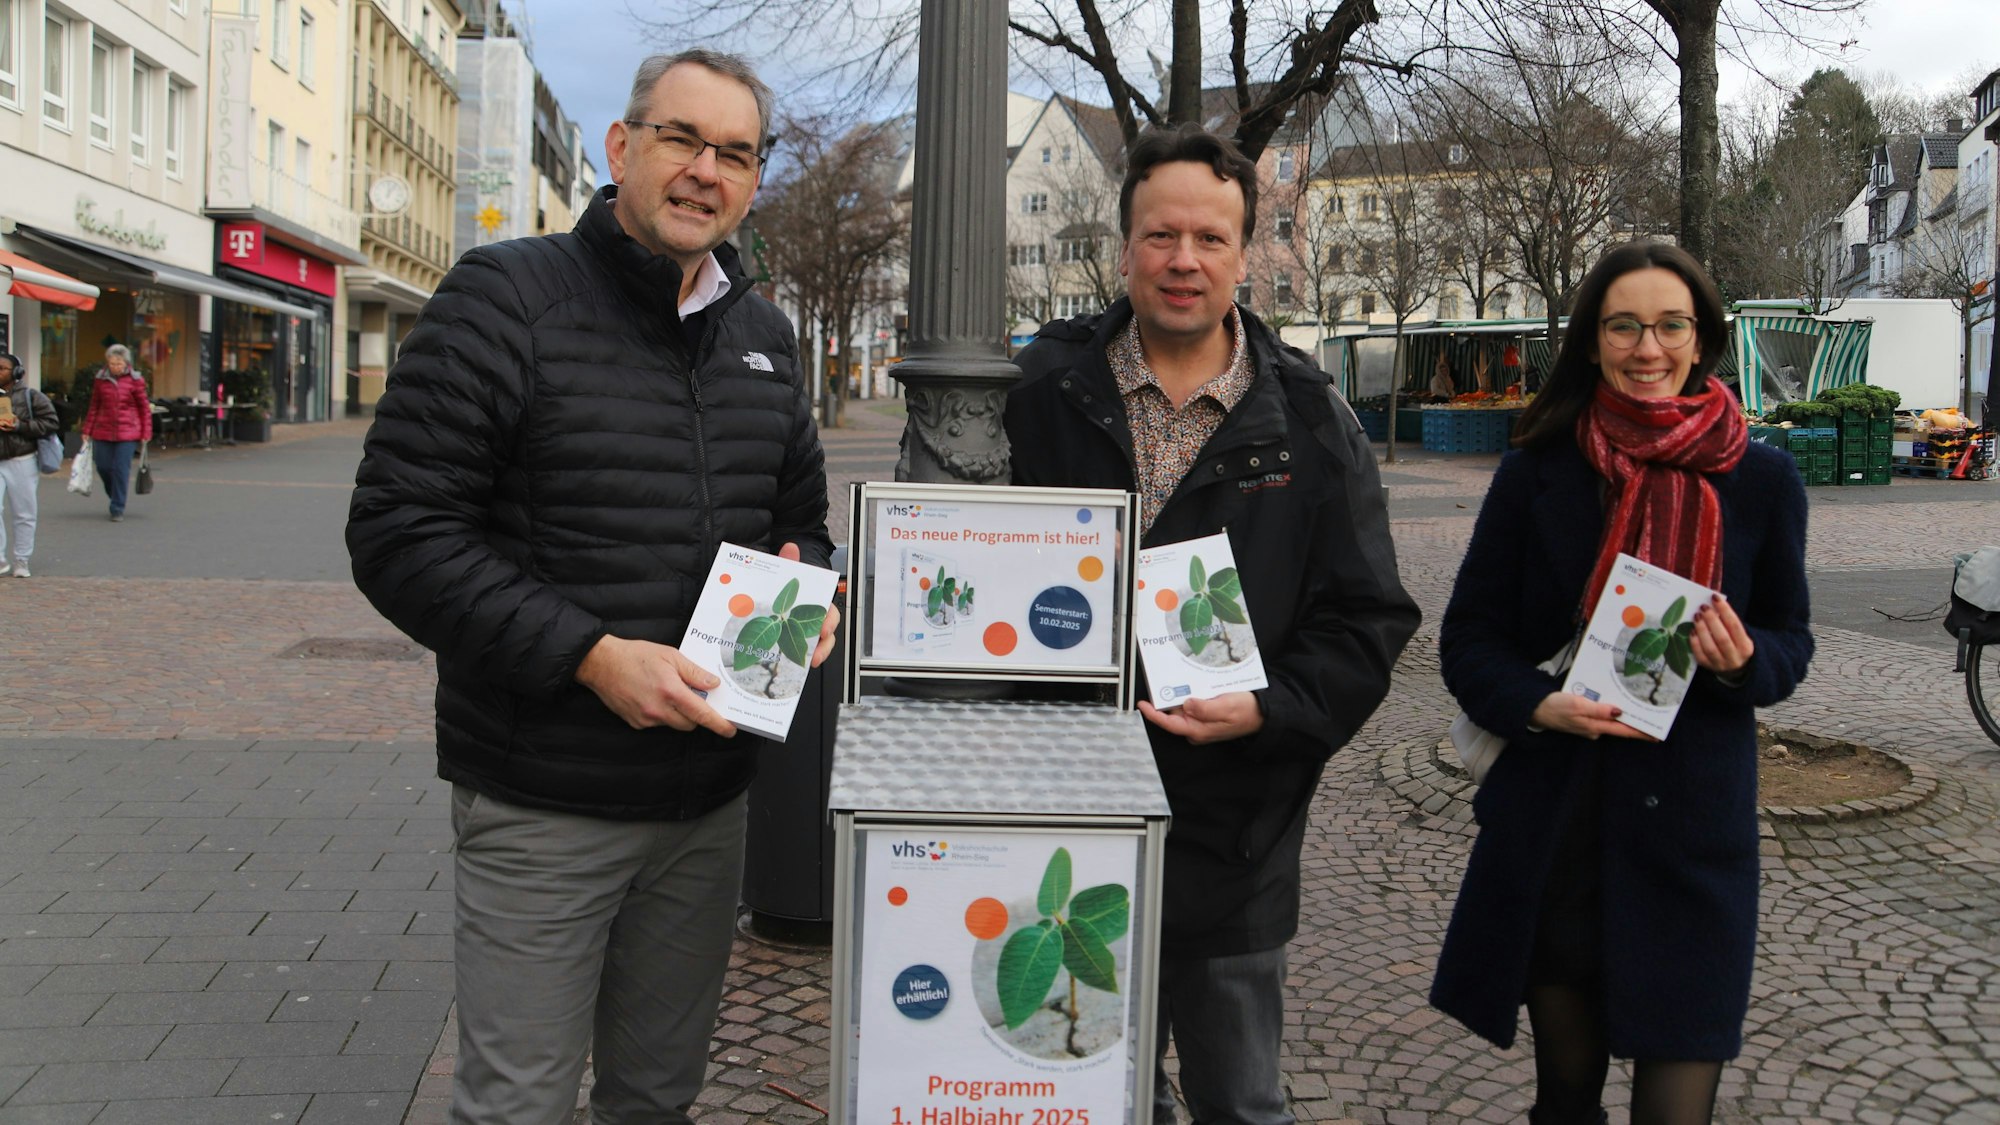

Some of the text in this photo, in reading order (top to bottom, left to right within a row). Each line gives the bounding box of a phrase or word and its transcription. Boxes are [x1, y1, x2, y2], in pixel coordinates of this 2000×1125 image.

[229, 230, 255, 258] T
[886, 504, 908, 516] vhs
[891, 527, 1100, 545] Das neue Programm ist hier!
[1034, 604, 1089, 620] Semesterstart:
[1039, 616, 1080, 631] 10.02.2025
[690, 628, 744, 652] Programm
[892, 840, 926, 857] vhs
[909, 980, 932, 991] Hier
[896, 988, 949, 1006] erhältlich!
[928, 1076, 1056, 1100] Programm
[891, 1107, 1090, 1125] 1. Halbjahr 2025
